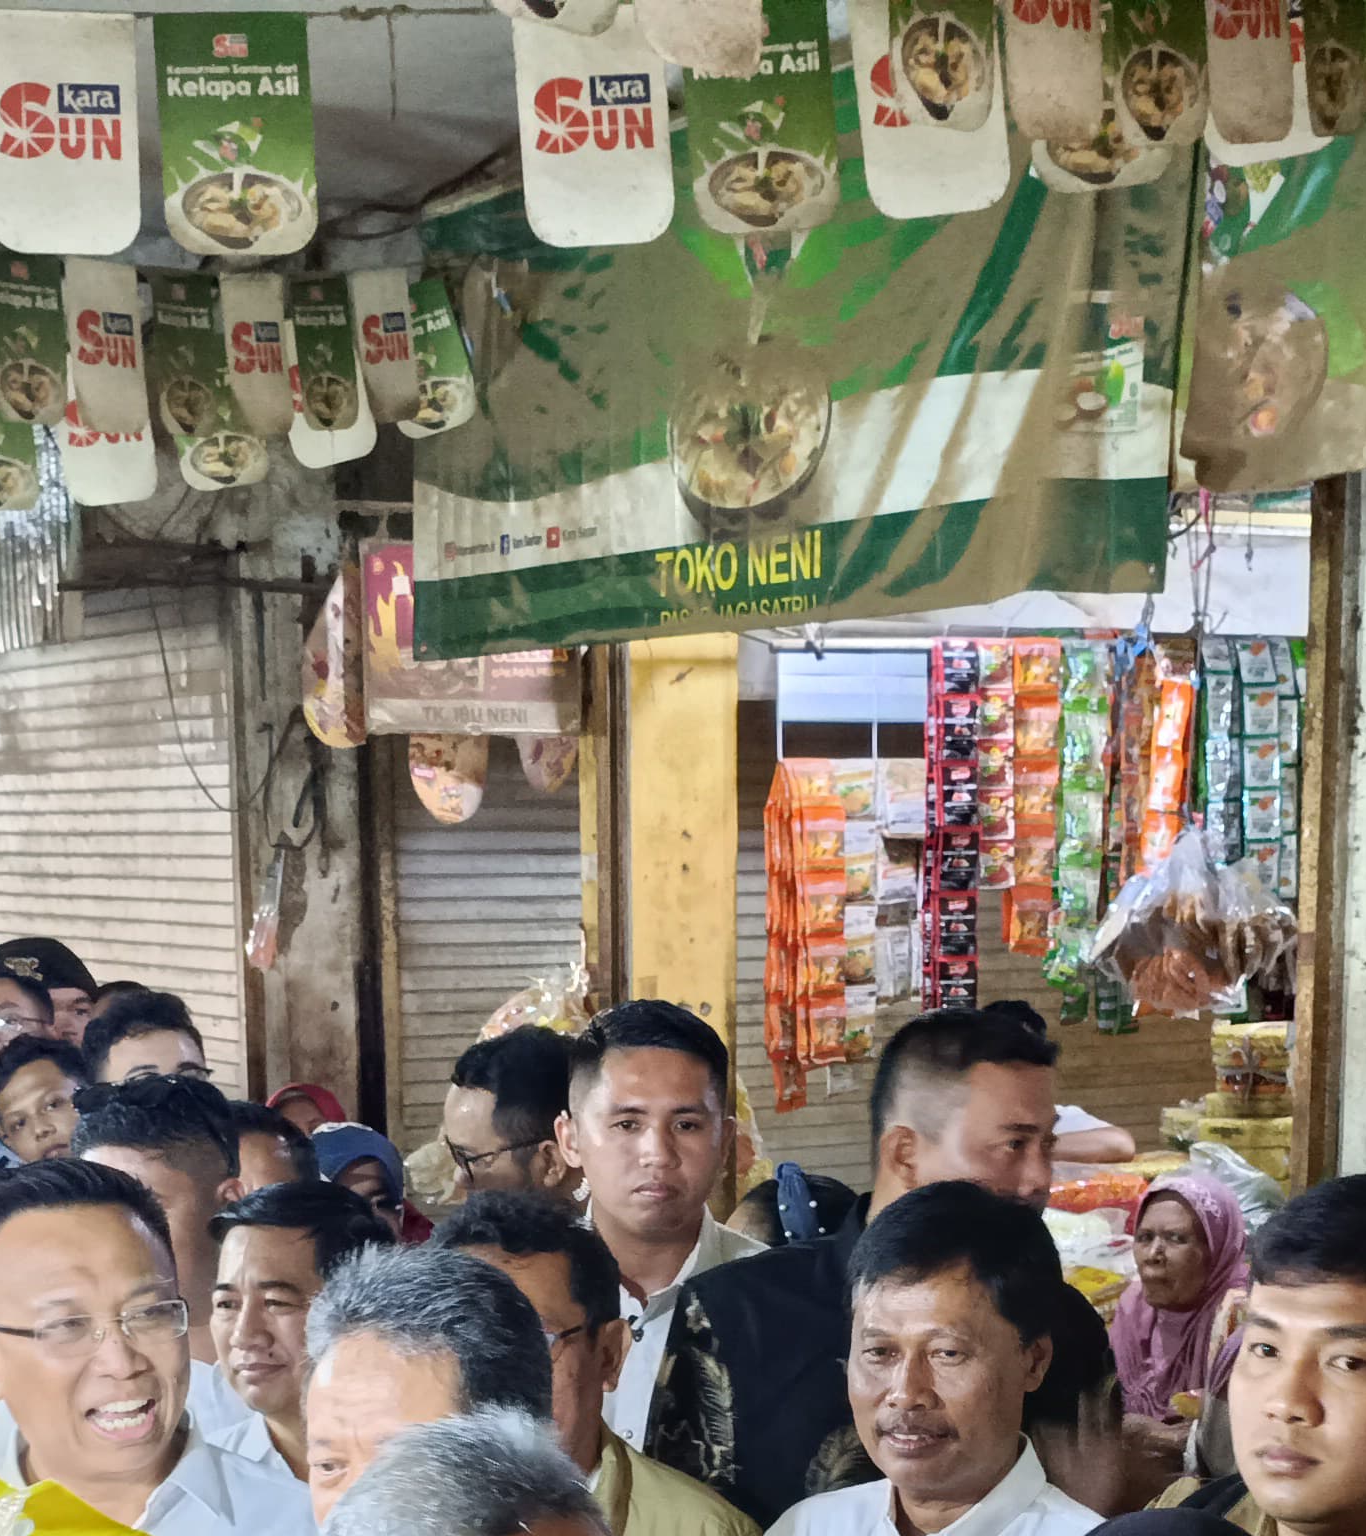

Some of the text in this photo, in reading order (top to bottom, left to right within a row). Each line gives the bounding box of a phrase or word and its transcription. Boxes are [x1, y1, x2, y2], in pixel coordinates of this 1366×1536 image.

[779, 51, 820, 74] Asli
[62, 83, 117, 113] kara
[166, 74, 300, 100] Kelapa Asli
[595, 78, 647, 104] kara
[534, 77, 654, 154] SUN
[77, 309, 136, 368] SUN
[232, 321, 284, 374] SUN
[363, 314, 410, 364] SUN
[655, 529, 822, 599] TOKO NENI
[481, 706, 528, 724] NENI
